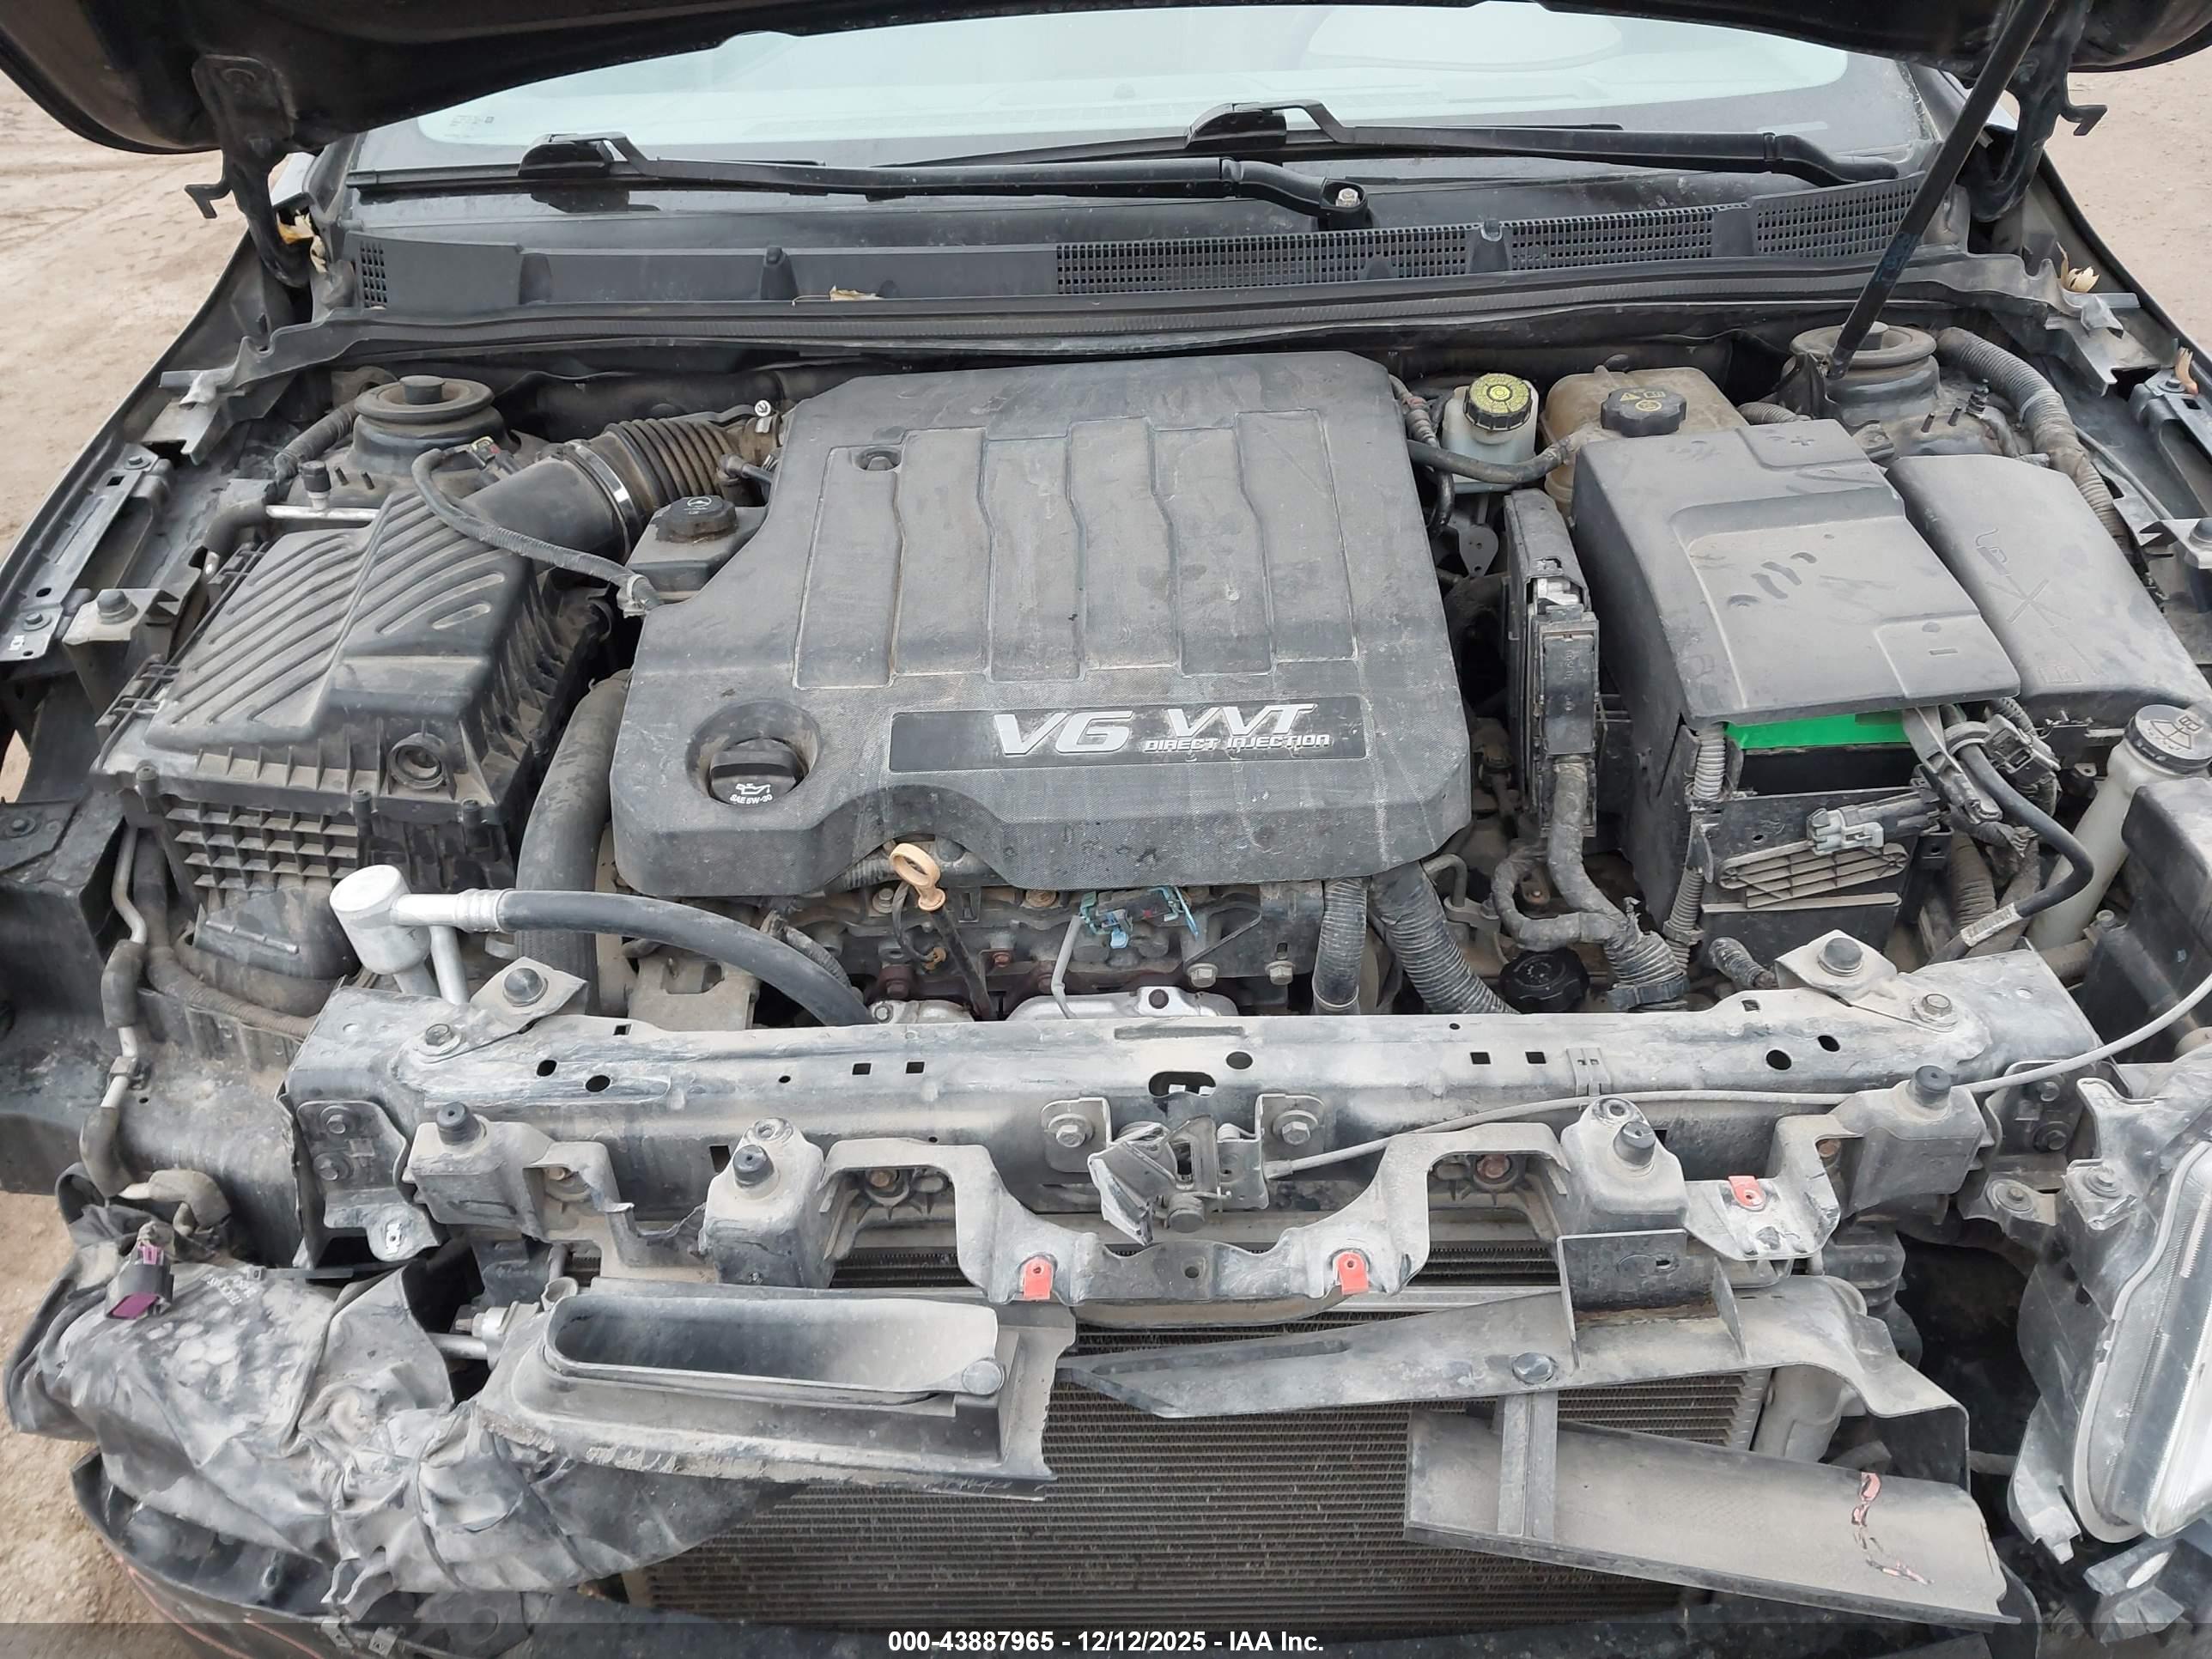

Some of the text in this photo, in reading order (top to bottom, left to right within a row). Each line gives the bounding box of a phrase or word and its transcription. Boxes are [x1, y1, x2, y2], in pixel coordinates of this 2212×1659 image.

[994, 703, 1318, 756] V6 VVT
[1143, 733, 1332, 753] DIRECT INJECTION
[729, 793, 746, 804] SAE
